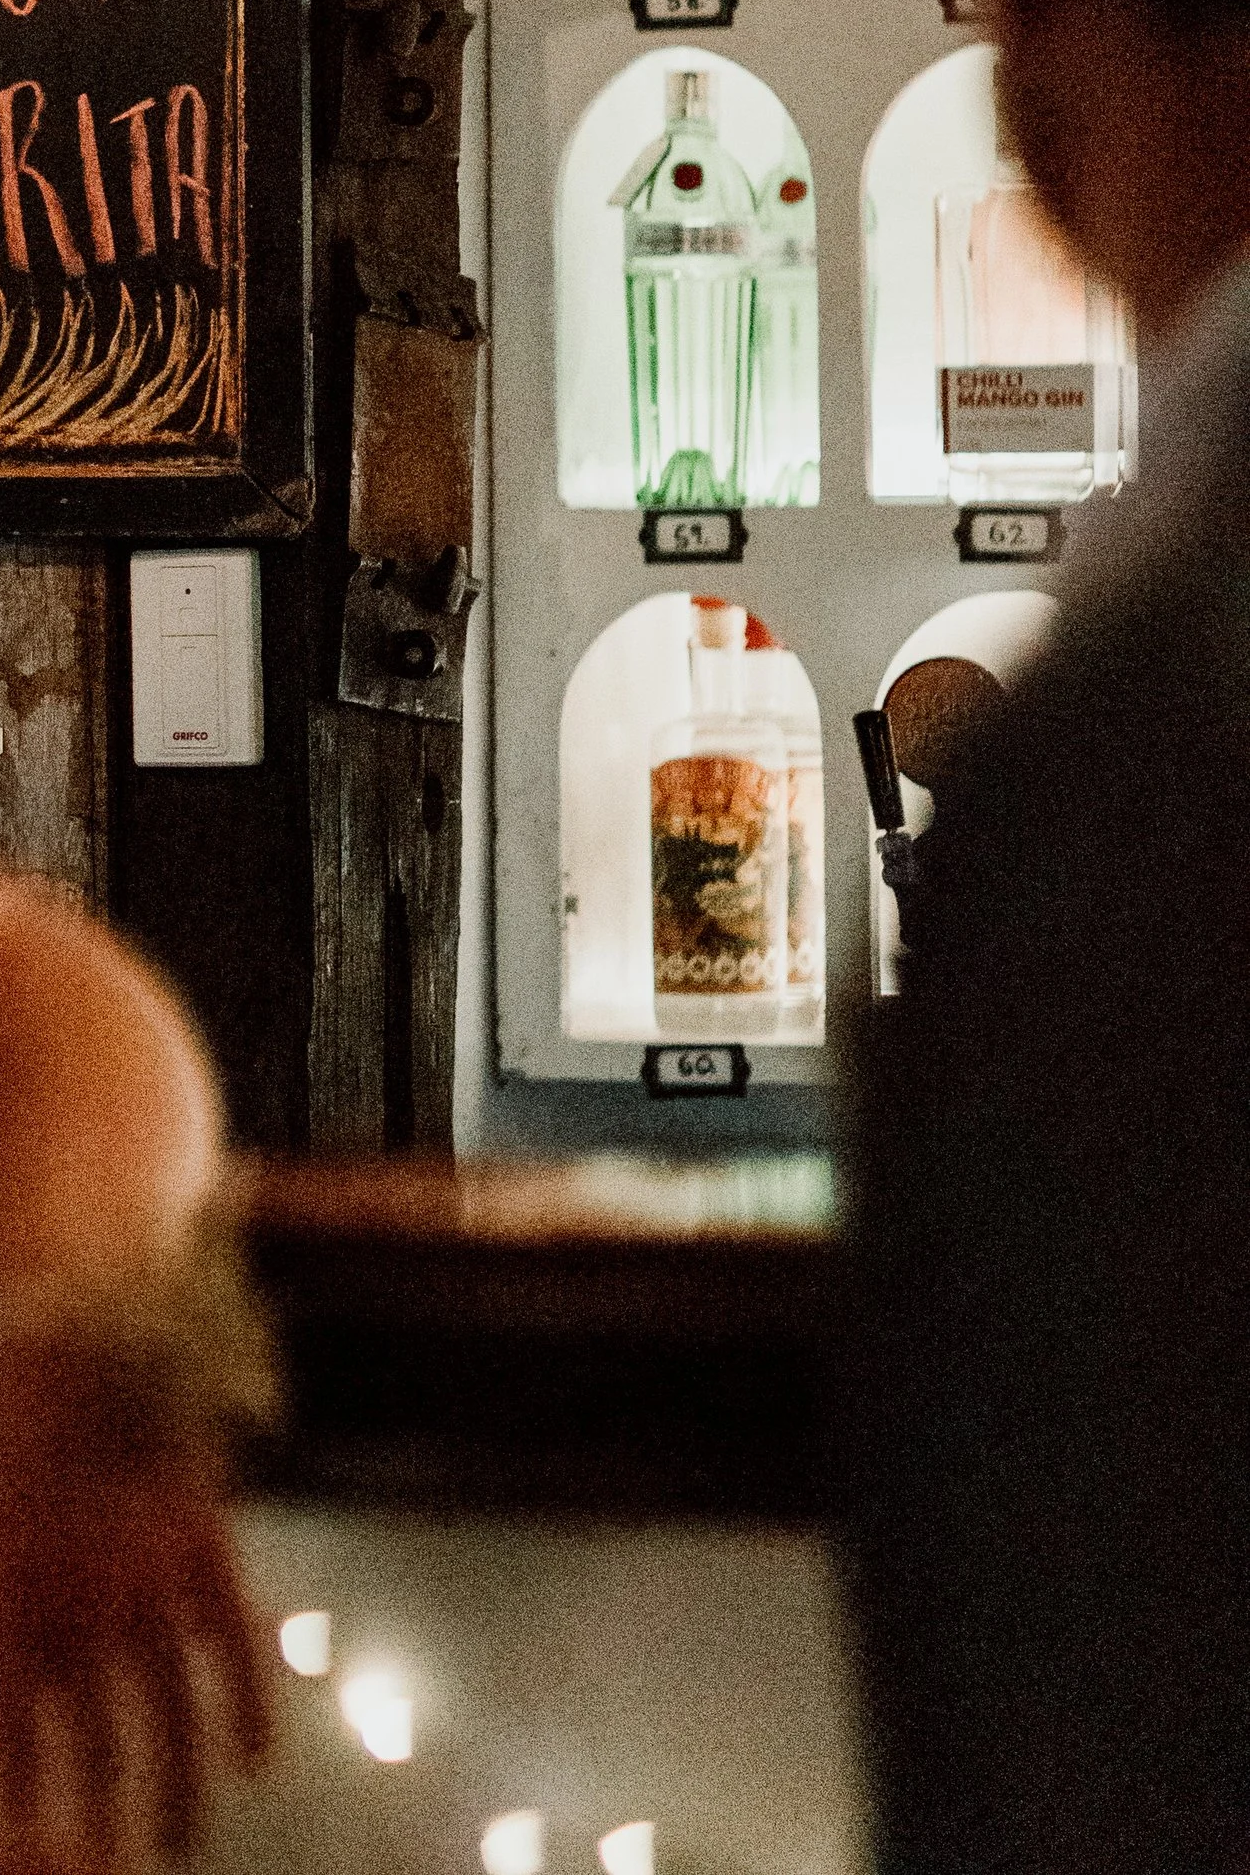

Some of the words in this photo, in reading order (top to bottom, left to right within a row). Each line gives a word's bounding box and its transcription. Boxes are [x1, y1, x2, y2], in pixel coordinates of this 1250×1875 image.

[957, 389, 1039, 408] MANGO
[1045, 388, 1086, 407] GIN
[172, 731, 209, 741] GRIFCO
